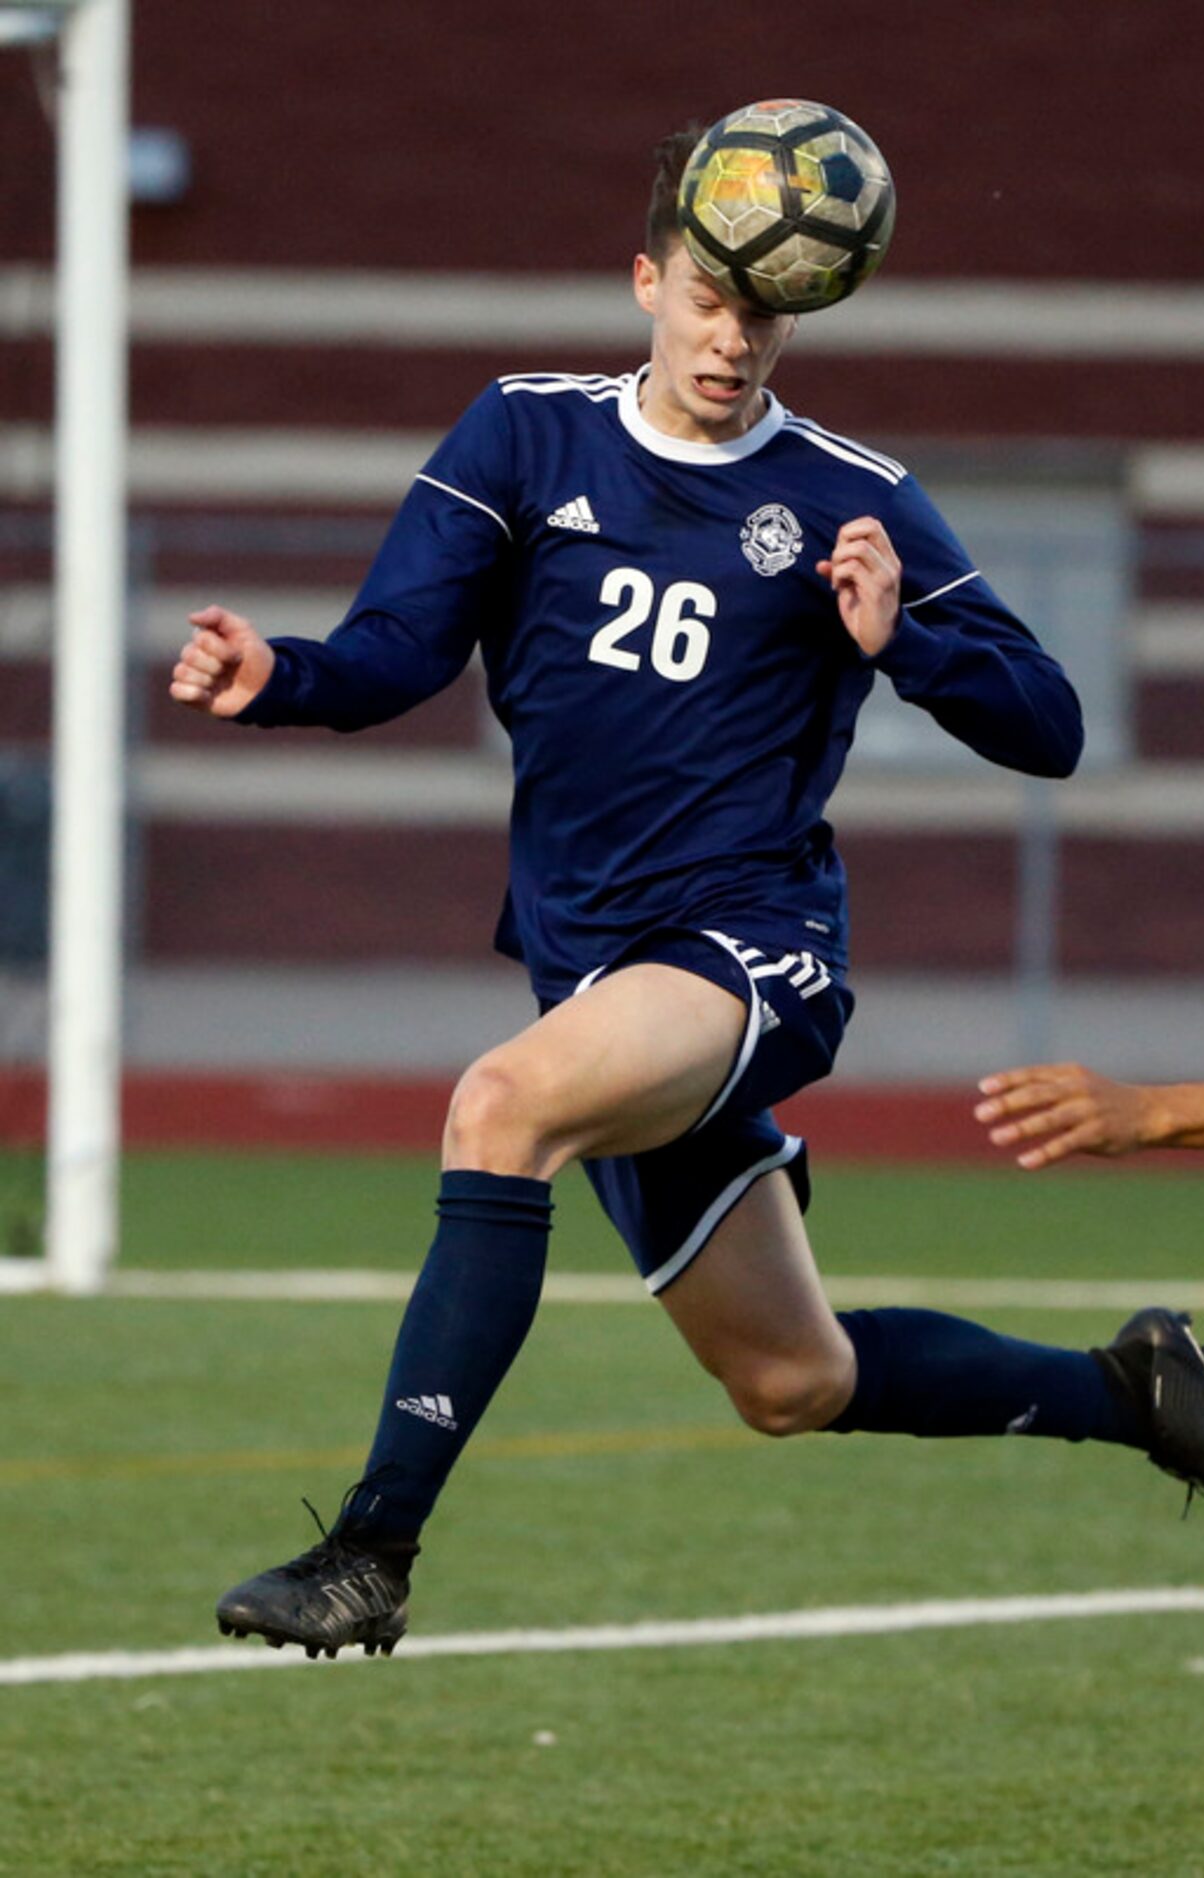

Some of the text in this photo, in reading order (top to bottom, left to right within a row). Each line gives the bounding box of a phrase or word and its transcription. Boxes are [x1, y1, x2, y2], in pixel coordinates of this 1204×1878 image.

[547, 513, 600, 534] adidas
[588, 566, 717, 682] 26
[396, 1399, 458, 1430] adidas
